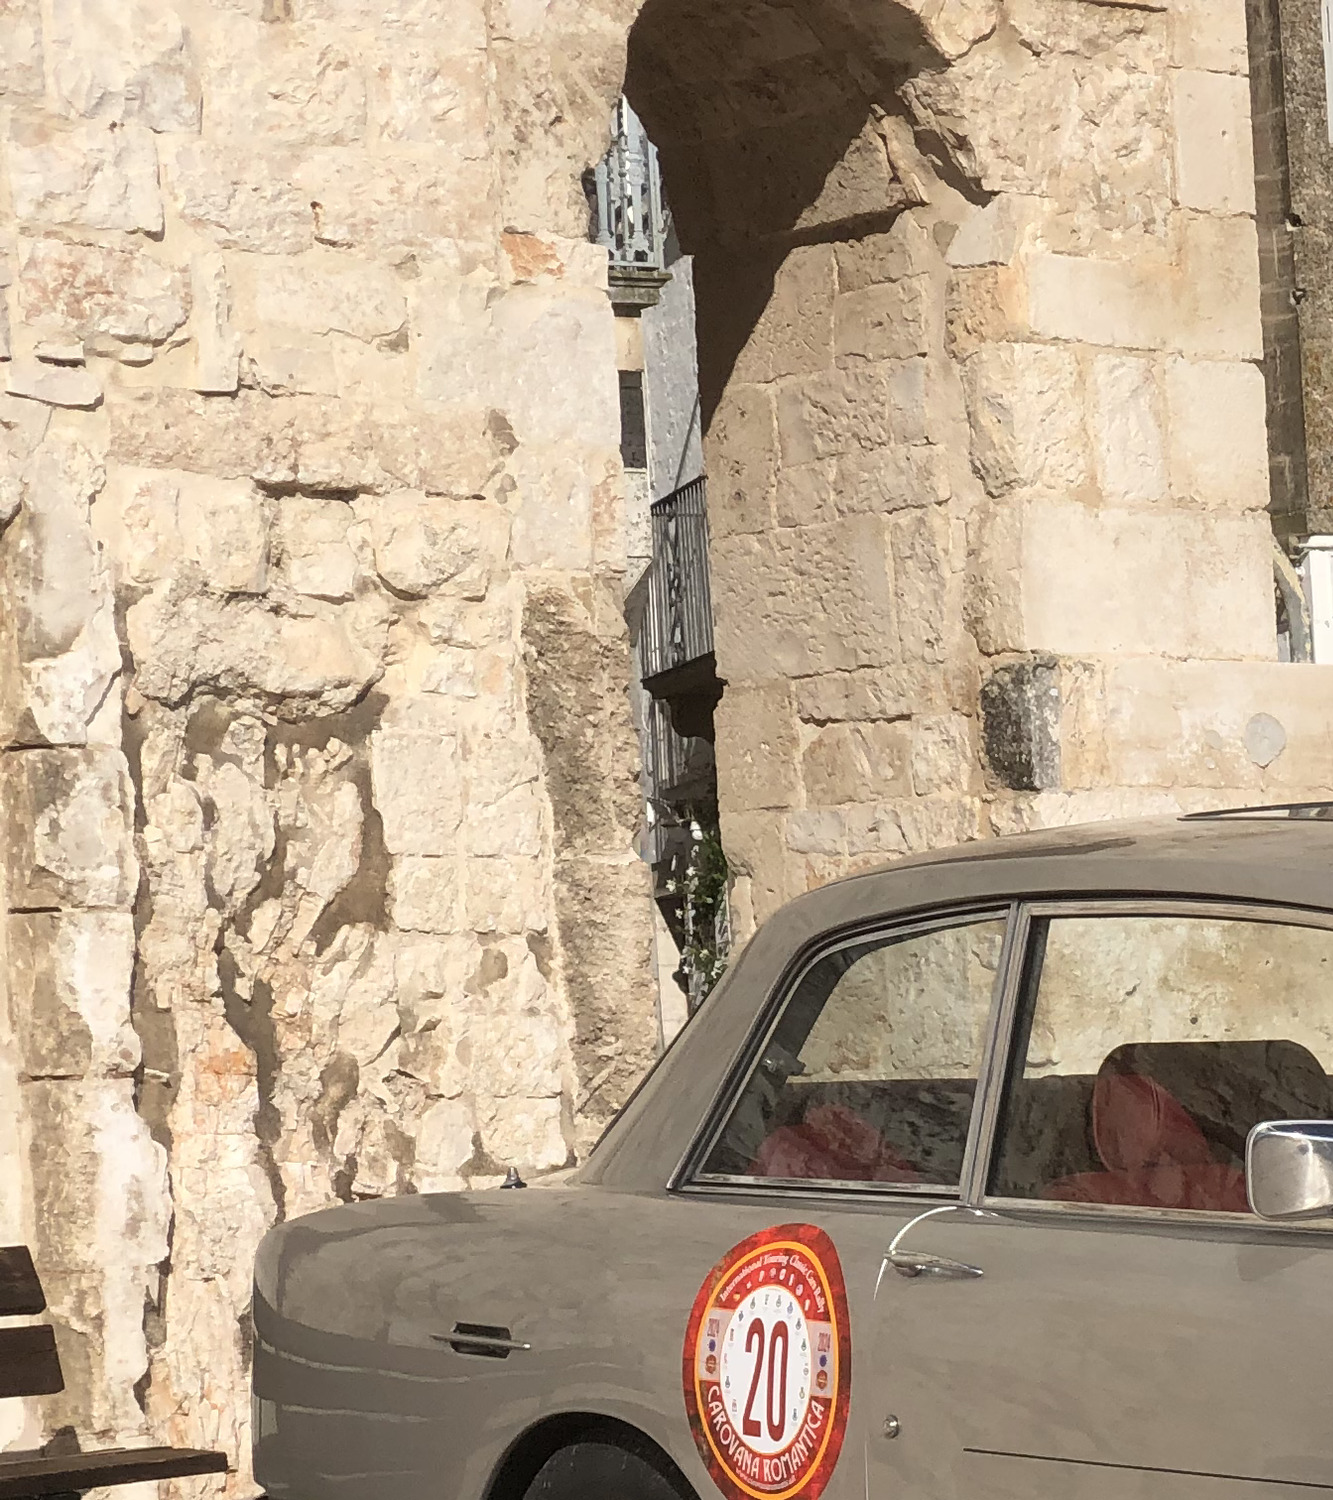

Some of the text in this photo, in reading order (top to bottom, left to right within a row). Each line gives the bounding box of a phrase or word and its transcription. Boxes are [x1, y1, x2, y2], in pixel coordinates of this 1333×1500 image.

[708, 1385, 825, 1482] CAROVANA ROMANTICA
[743, 1317, 789, 1442] 20
